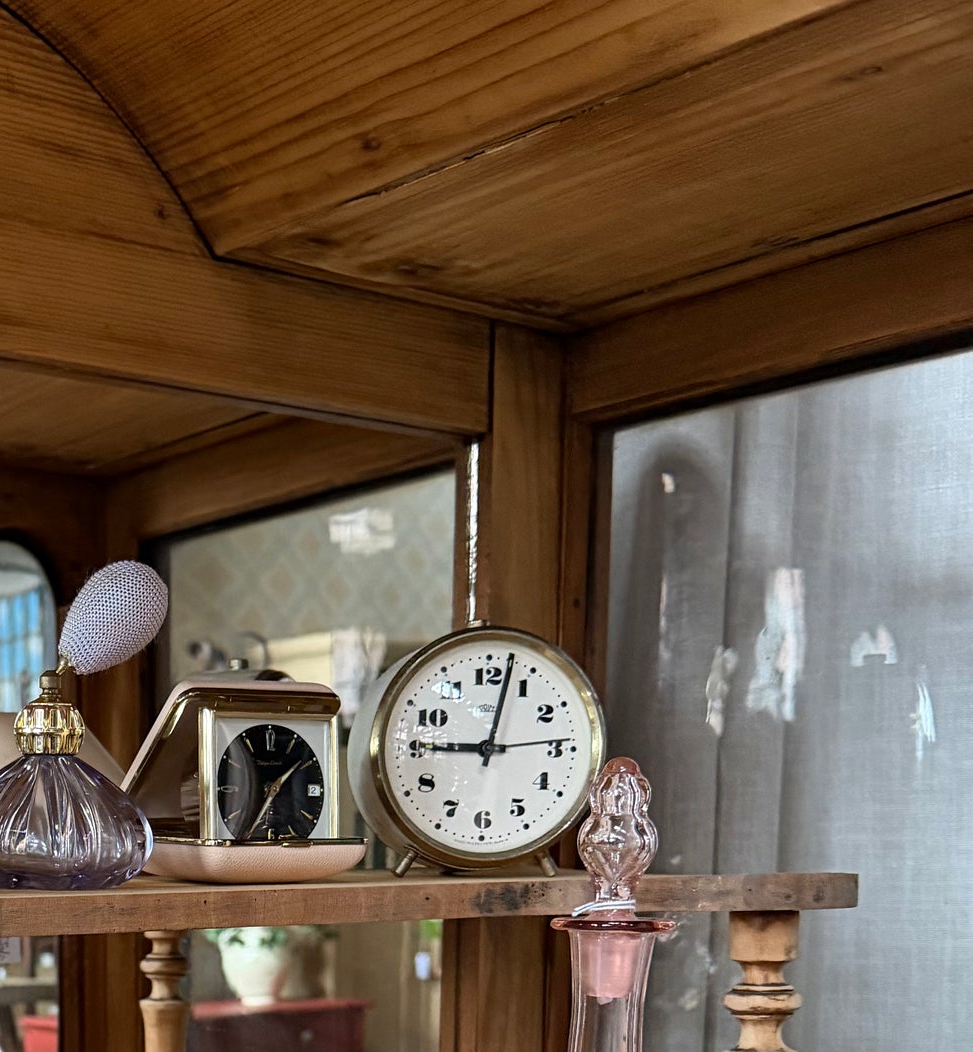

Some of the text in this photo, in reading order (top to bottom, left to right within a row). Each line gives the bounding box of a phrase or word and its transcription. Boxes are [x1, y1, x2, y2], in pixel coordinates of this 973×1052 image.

[473, 666, 503, 687] 12
[517, 679, 528, 698] 1
[417, 708, 448, 728] 10
[536, 703, 555, 724] 2
[547, 740, 563, 758] 3
[417, 773, 436, 793] 8
[532, 771, 551, 791] 4
[442, 798, 460, 818] 7
[509, 798, 526, 817] 5
[473, 810, 493, 830] 6
